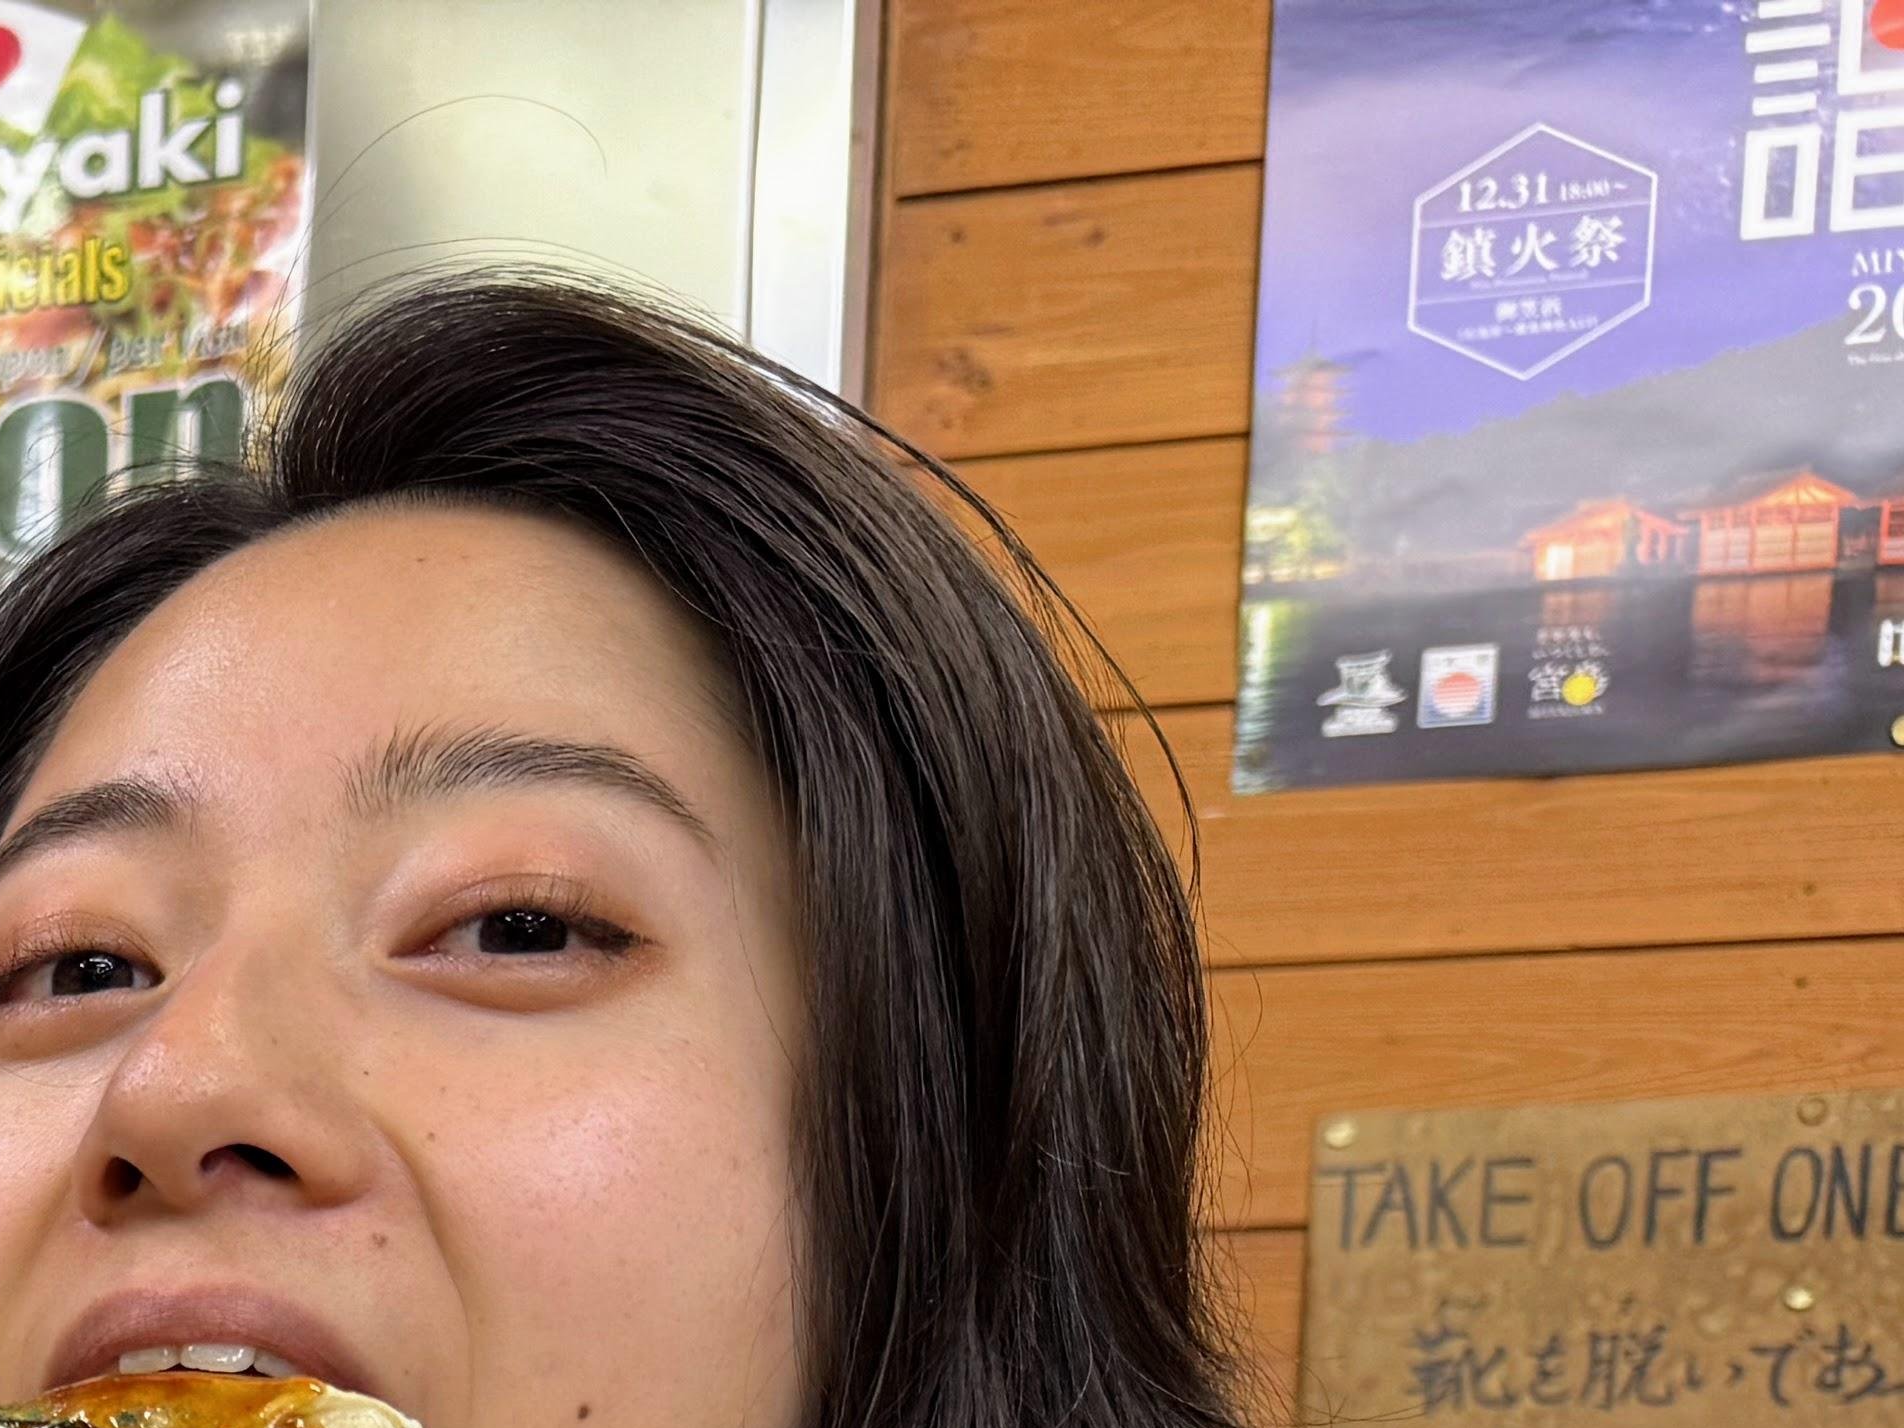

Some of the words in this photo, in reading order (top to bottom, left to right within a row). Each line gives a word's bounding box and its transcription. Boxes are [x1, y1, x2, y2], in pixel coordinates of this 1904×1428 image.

[1458, 172, 1550, 213] 12.31
[1316, 1154, 1534, 1250] TAKE
[1579, 1147, 1743, 1250] OFF
